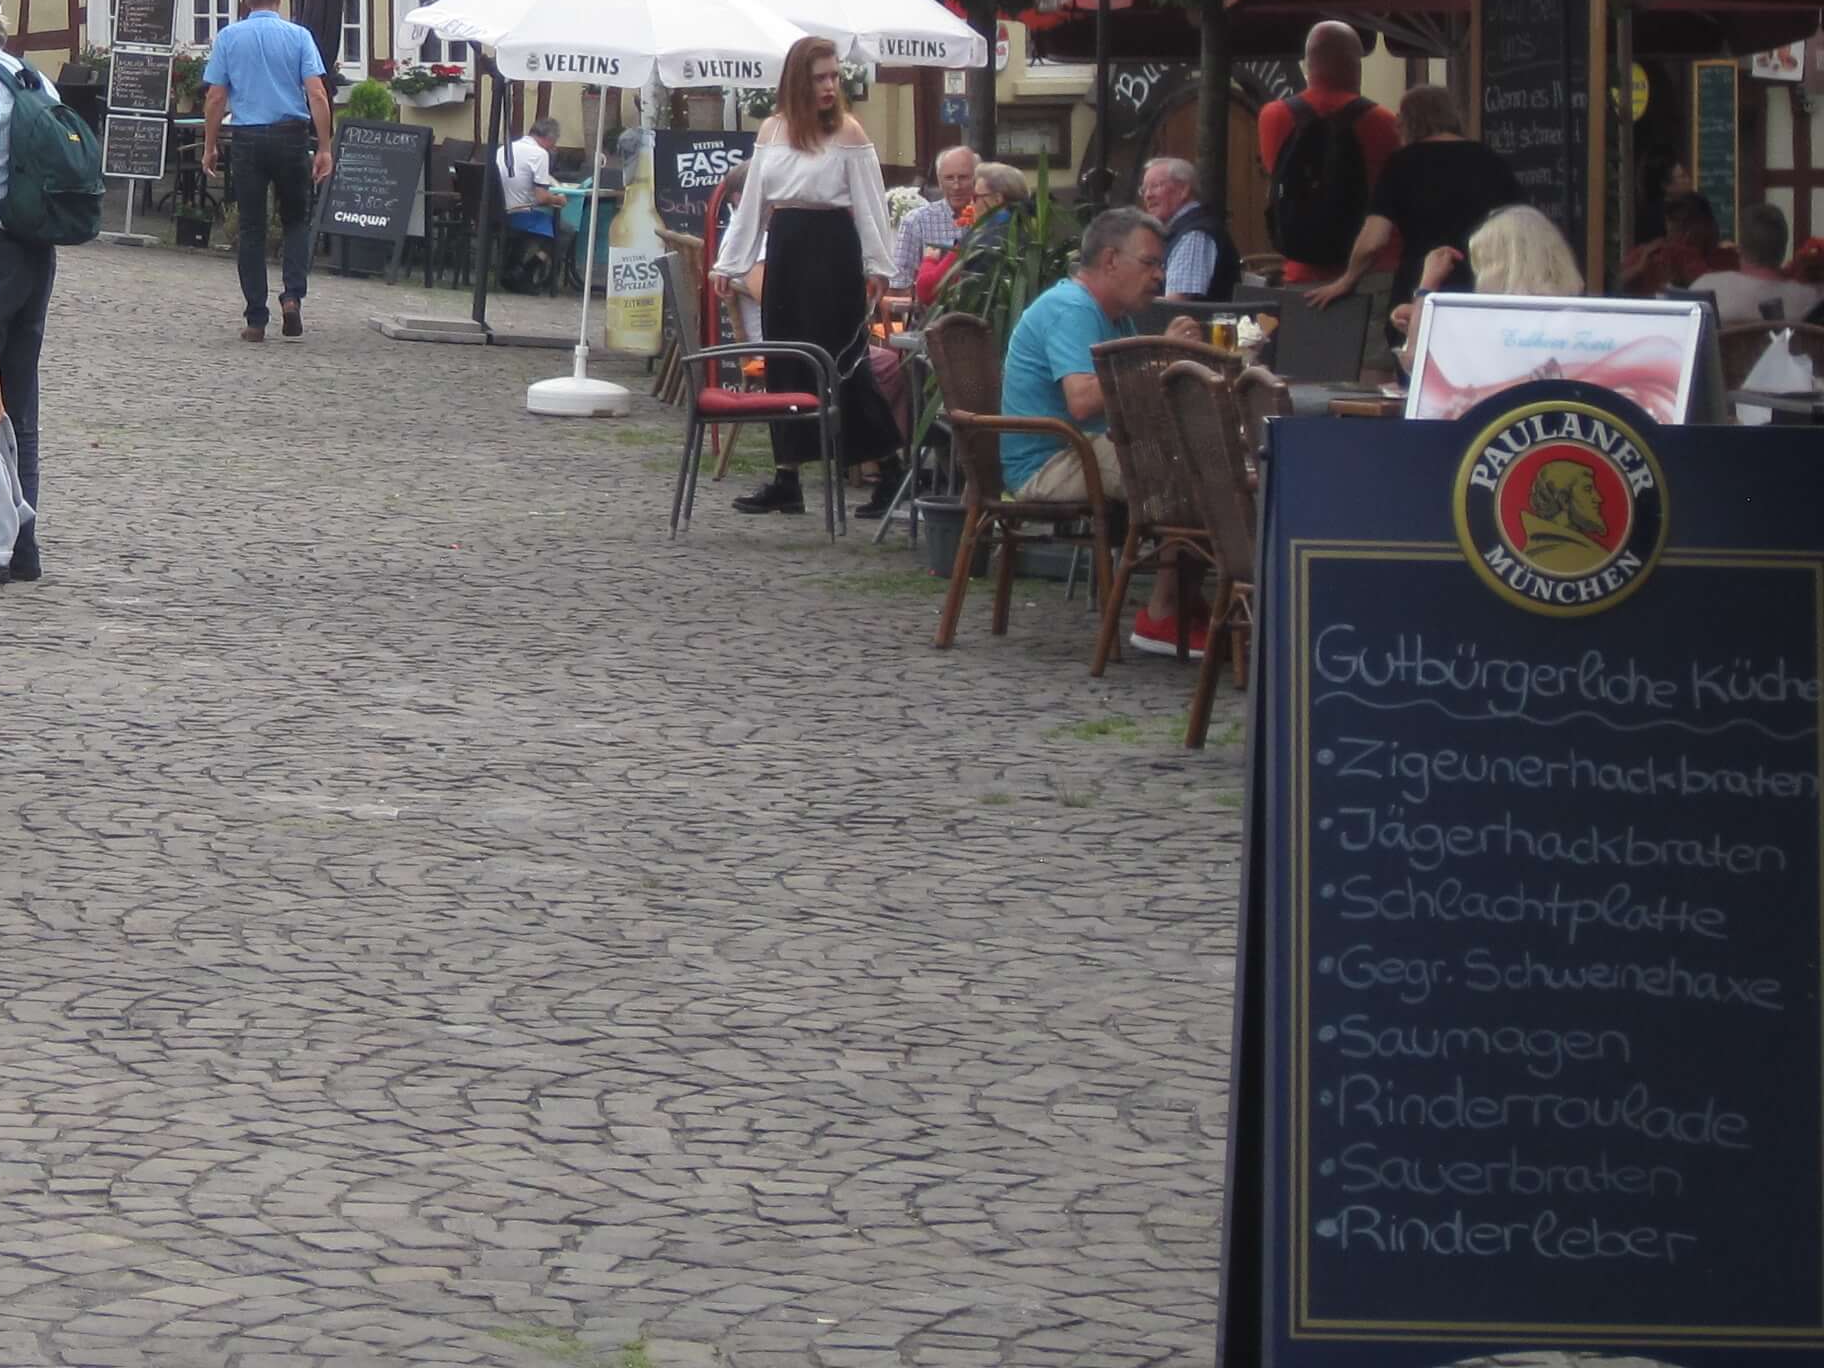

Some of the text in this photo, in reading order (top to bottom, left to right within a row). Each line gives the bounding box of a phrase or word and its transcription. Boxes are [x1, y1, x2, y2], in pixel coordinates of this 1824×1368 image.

[544, 53, 620, 75] VELTINS
[697, 60, 763, 78] VELTINS
[887, 38, 946, 58] VELTINS
[347, 127, 381, 143] PIZZA
[676, 149, 744, 175] FASS
[677, 170, 725, 188] Brau
[334, 211, 388, 227] CHAQWA
[612, 262, 660, 281] FASS
[1470, 412, 1654, 498] PAULANER
[1483, 543, 1643, 604] MÜNCHEN
[1314, 624, 1823, 716] Gutbürgerliche Küche
[1337, 737, 1821, 803] Zigeunerhackbraten
[1338, 804, 1787, 873] Jägerhackbraten
[1339, 874, 1729, 944] Schlachtplatte
[1337, 944, 1785, 1010] Gegr. Schweinehaxe
[1339, 1014, 1632, 1079] Saumagen
[1338, 1074, 1753, 1149] Rinderroulade
[1339, 1143, 1684, 1196] Sauerbraten
[1337, 1205, 1699, 1263] Rinderleber
